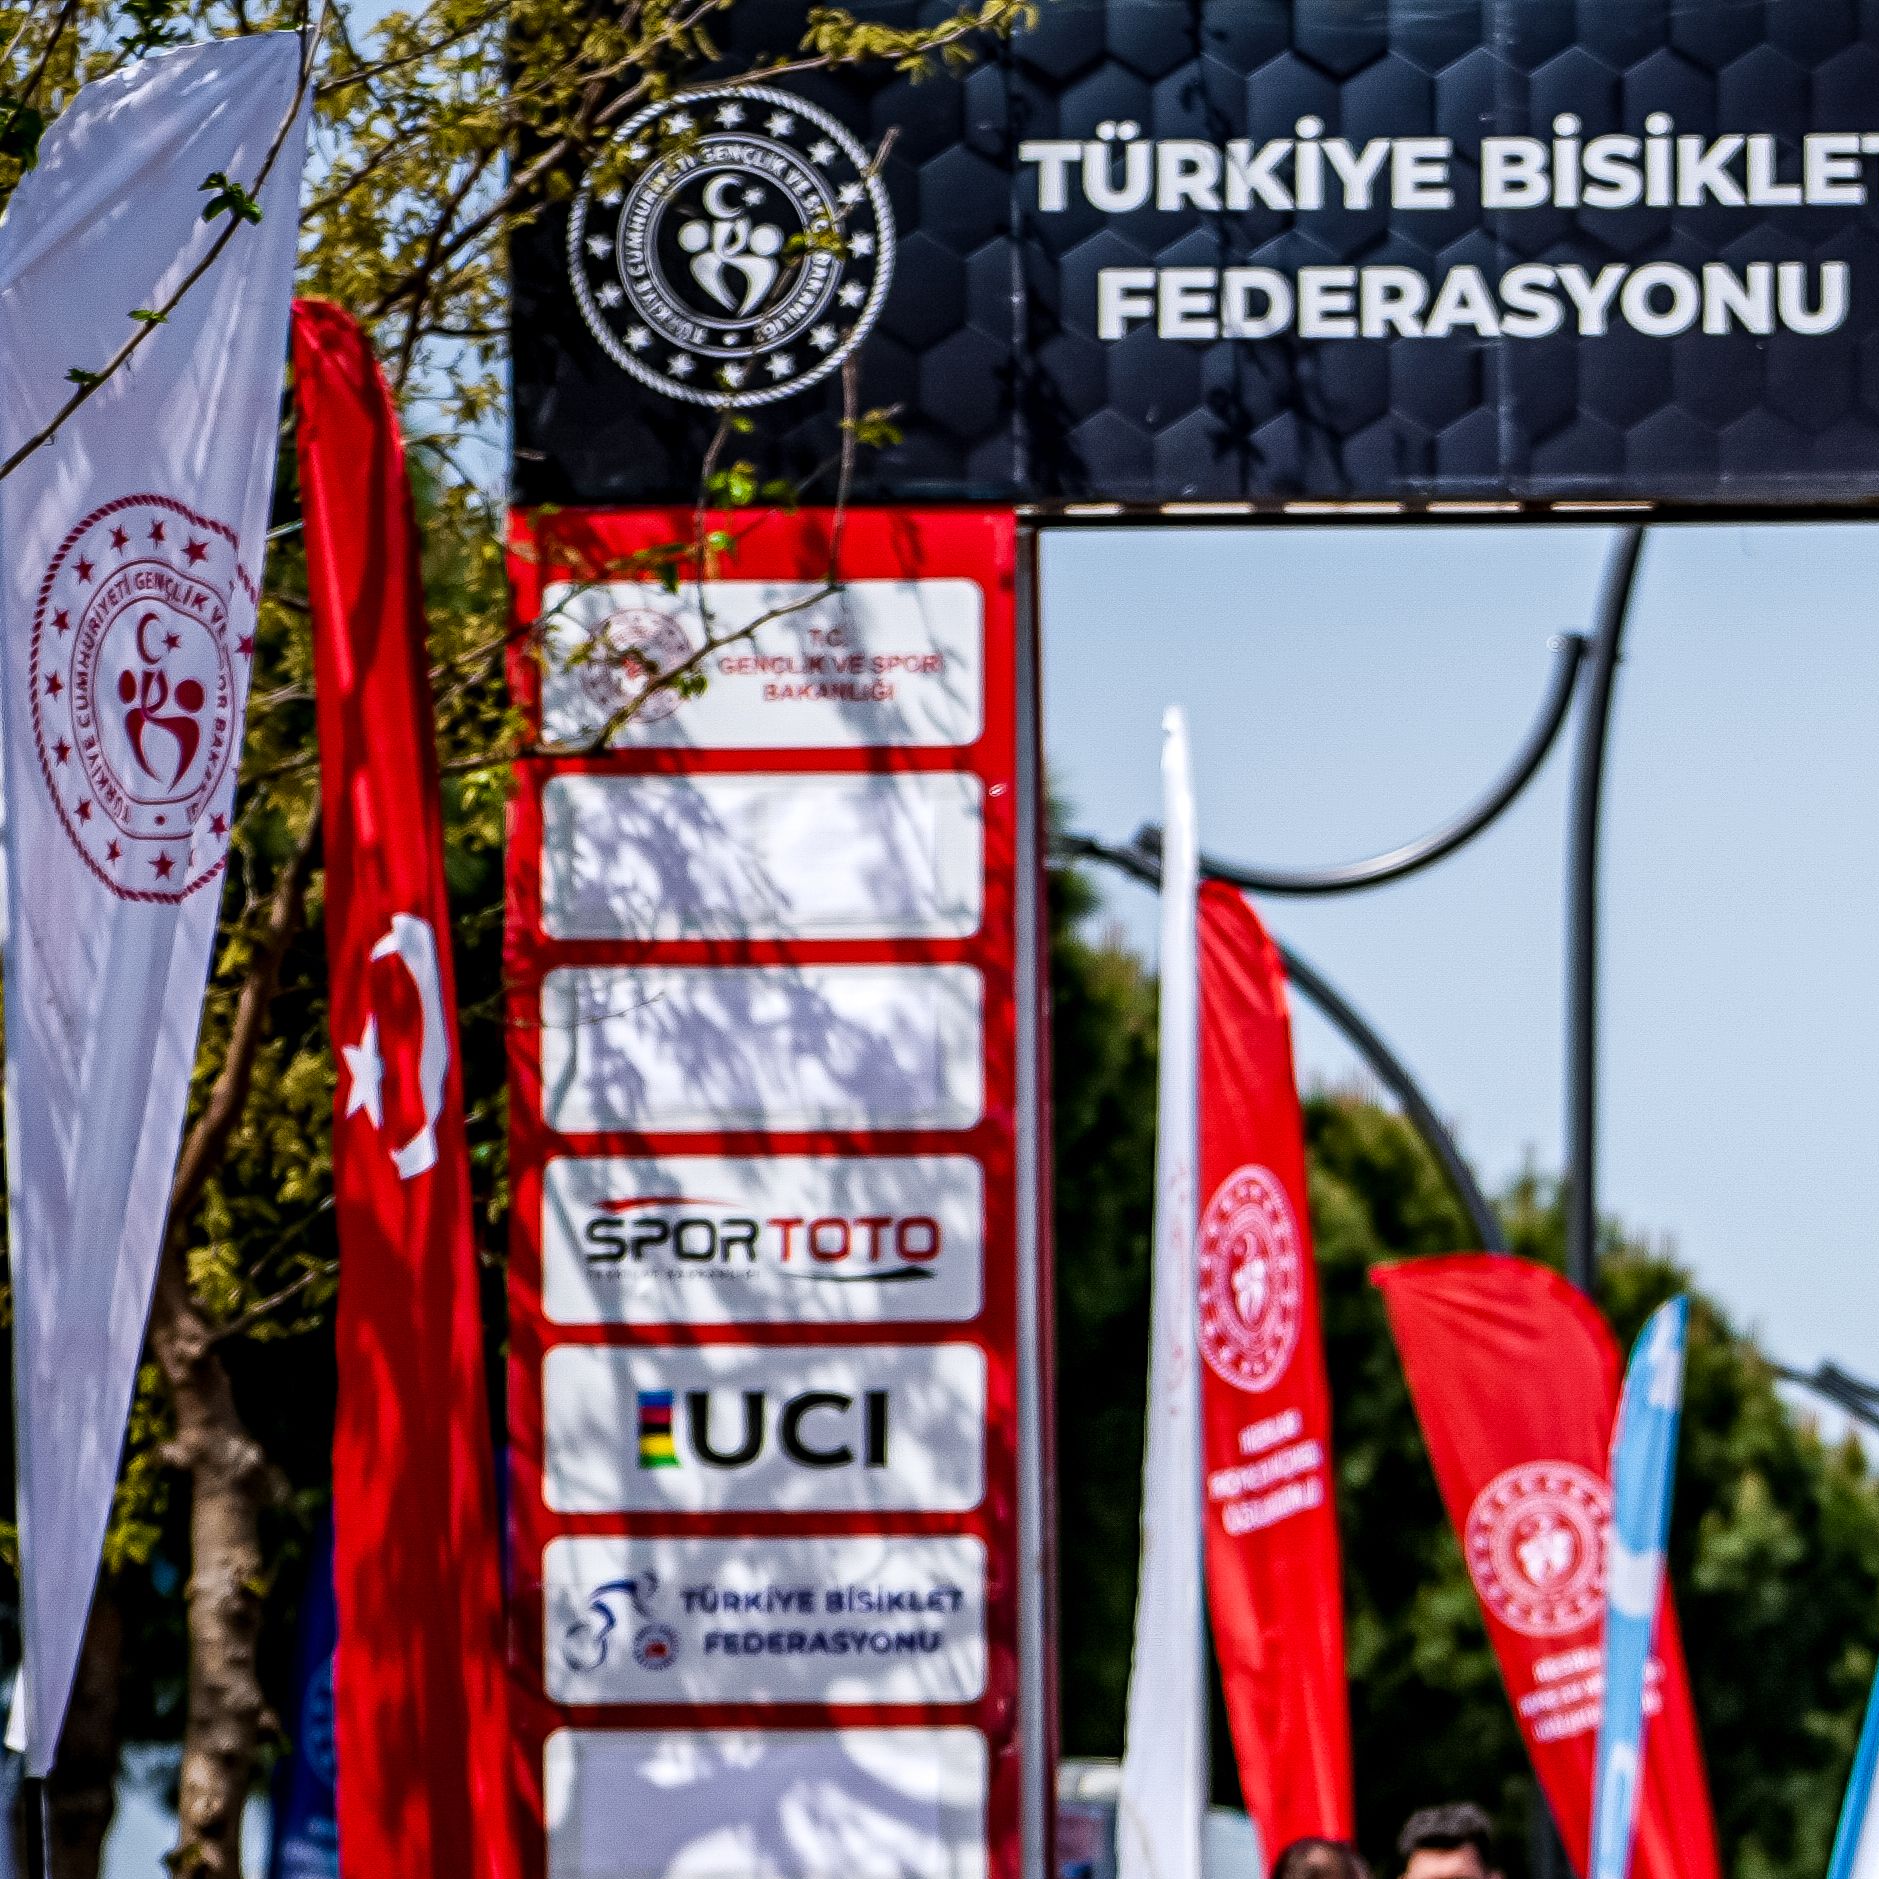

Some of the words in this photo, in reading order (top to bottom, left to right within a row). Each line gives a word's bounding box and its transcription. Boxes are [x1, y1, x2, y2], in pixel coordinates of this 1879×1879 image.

[1019, 114, 1454, 213] TÜRKİYE
[1097, 260, 1849, 340] FEDERASYONU
[684, 1389, 888, 1468] UCI
[681, 1583, 814, 1614] TÜRKİYE
[825, 1583, 963, 1614] BİSİKLET
[704, 1630, 941, 1655] FEDERASYONU
